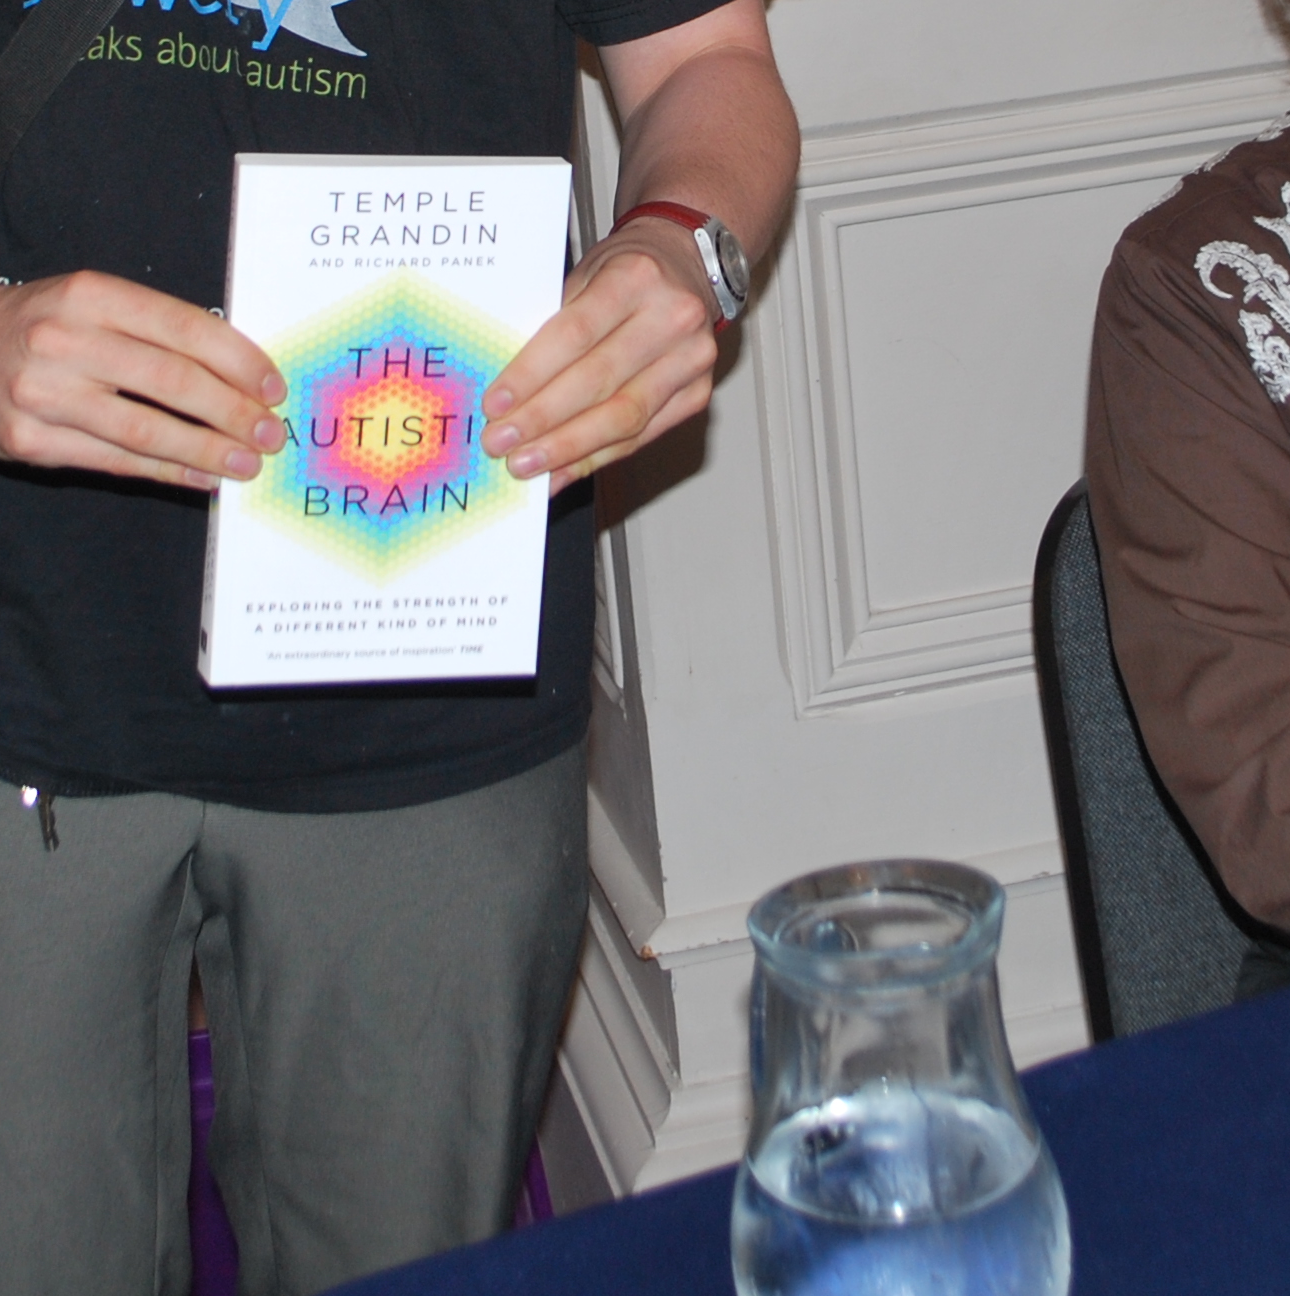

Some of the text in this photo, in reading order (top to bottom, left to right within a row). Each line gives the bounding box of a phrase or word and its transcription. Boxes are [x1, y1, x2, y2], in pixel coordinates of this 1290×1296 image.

[246, 57, 368, 100] autism
[329, 191, 485, 214] TEMPLE
[310, 223, 498, 247] GRANDIN
[308, 255, 496, 269] AND RICHARD PANEK
[347, 346, 448, 379] THE
[283, 413, 475, 448] AUTISTI
[304, 481, 469, 517] BRAIN
[245, 595, 509, 614] EXPLORING THE STRENGTH OF
[254, 616, 498, 634] A DIFFERENT KIND OF MIND
[284, 648, 351, 661] extraordinary
[354, 647, 387, 658] source
[390, 646, 401, 657] of
[460, 644, 484, 655] TIME
